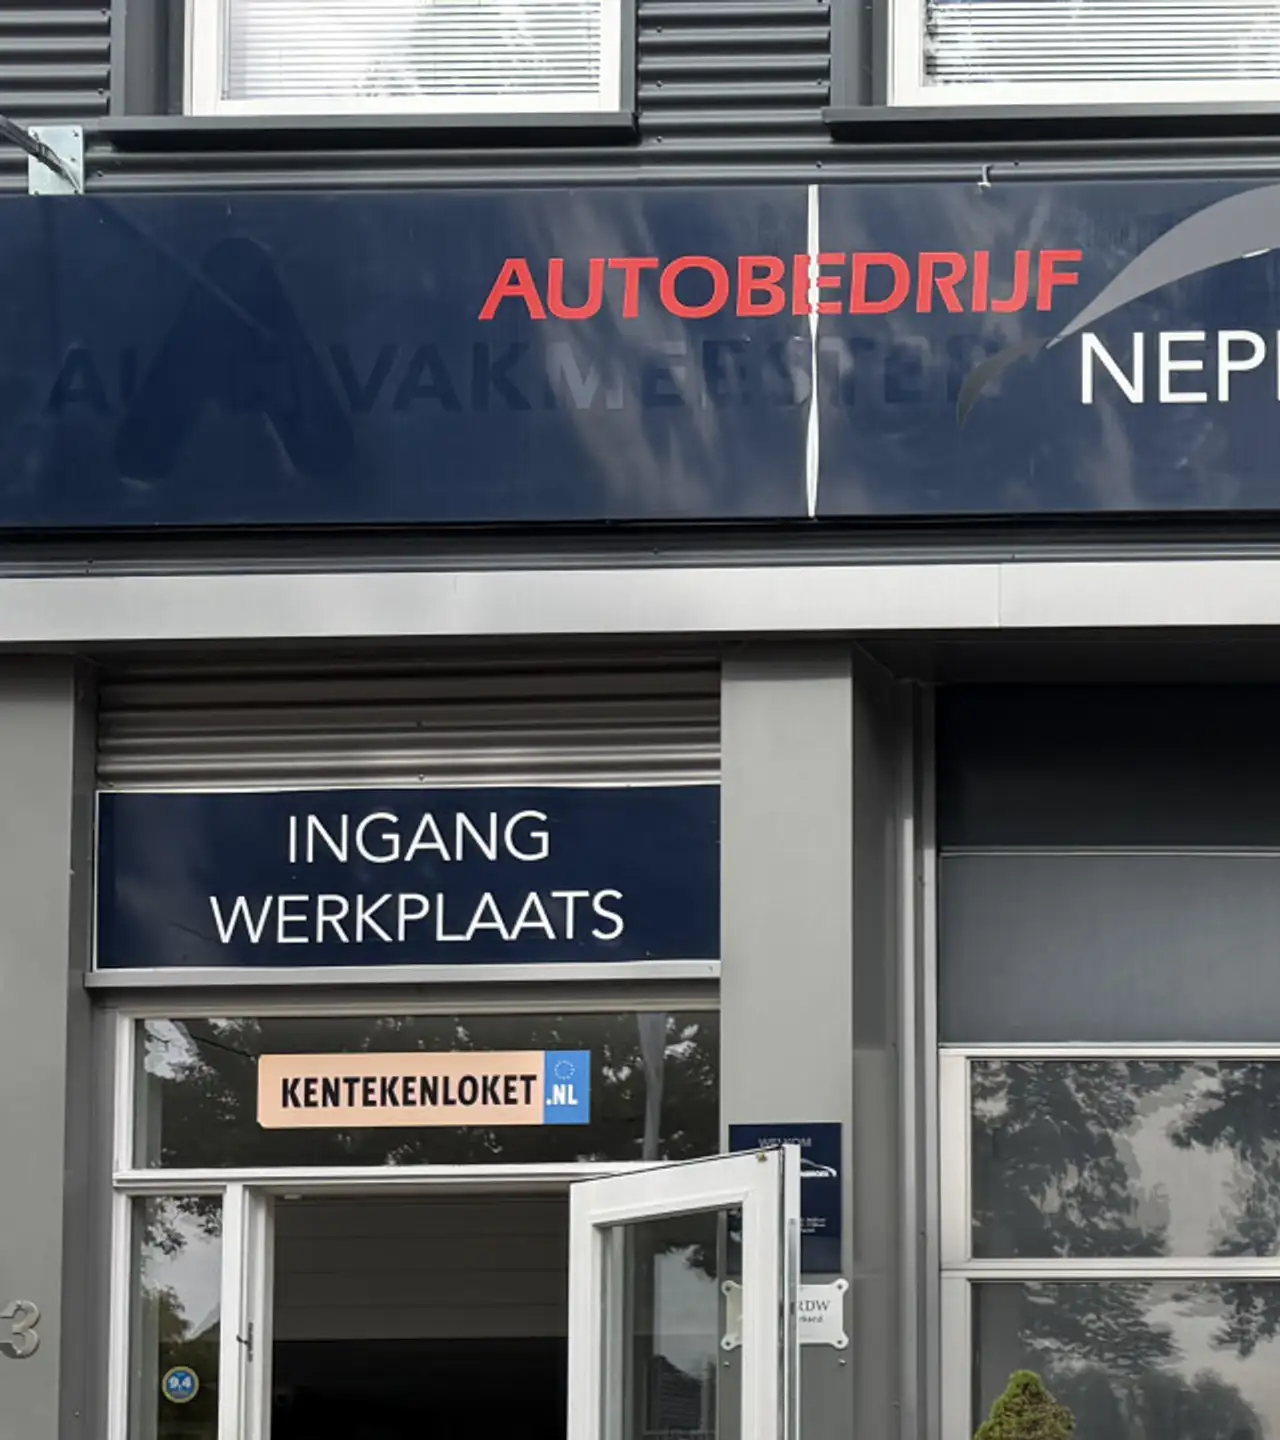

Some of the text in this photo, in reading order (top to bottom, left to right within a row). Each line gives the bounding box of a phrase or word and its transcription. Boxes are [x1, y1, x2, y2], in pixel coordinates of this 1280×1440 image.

[479, 248, 1083, 321] AUTOBEDRIJF
[288, 810, 550, 863] INGANG
[210, 889, 625, 944] WERKPLAATS
[281, 1074, 578, 1108] KENTEKENLOKET .NL
